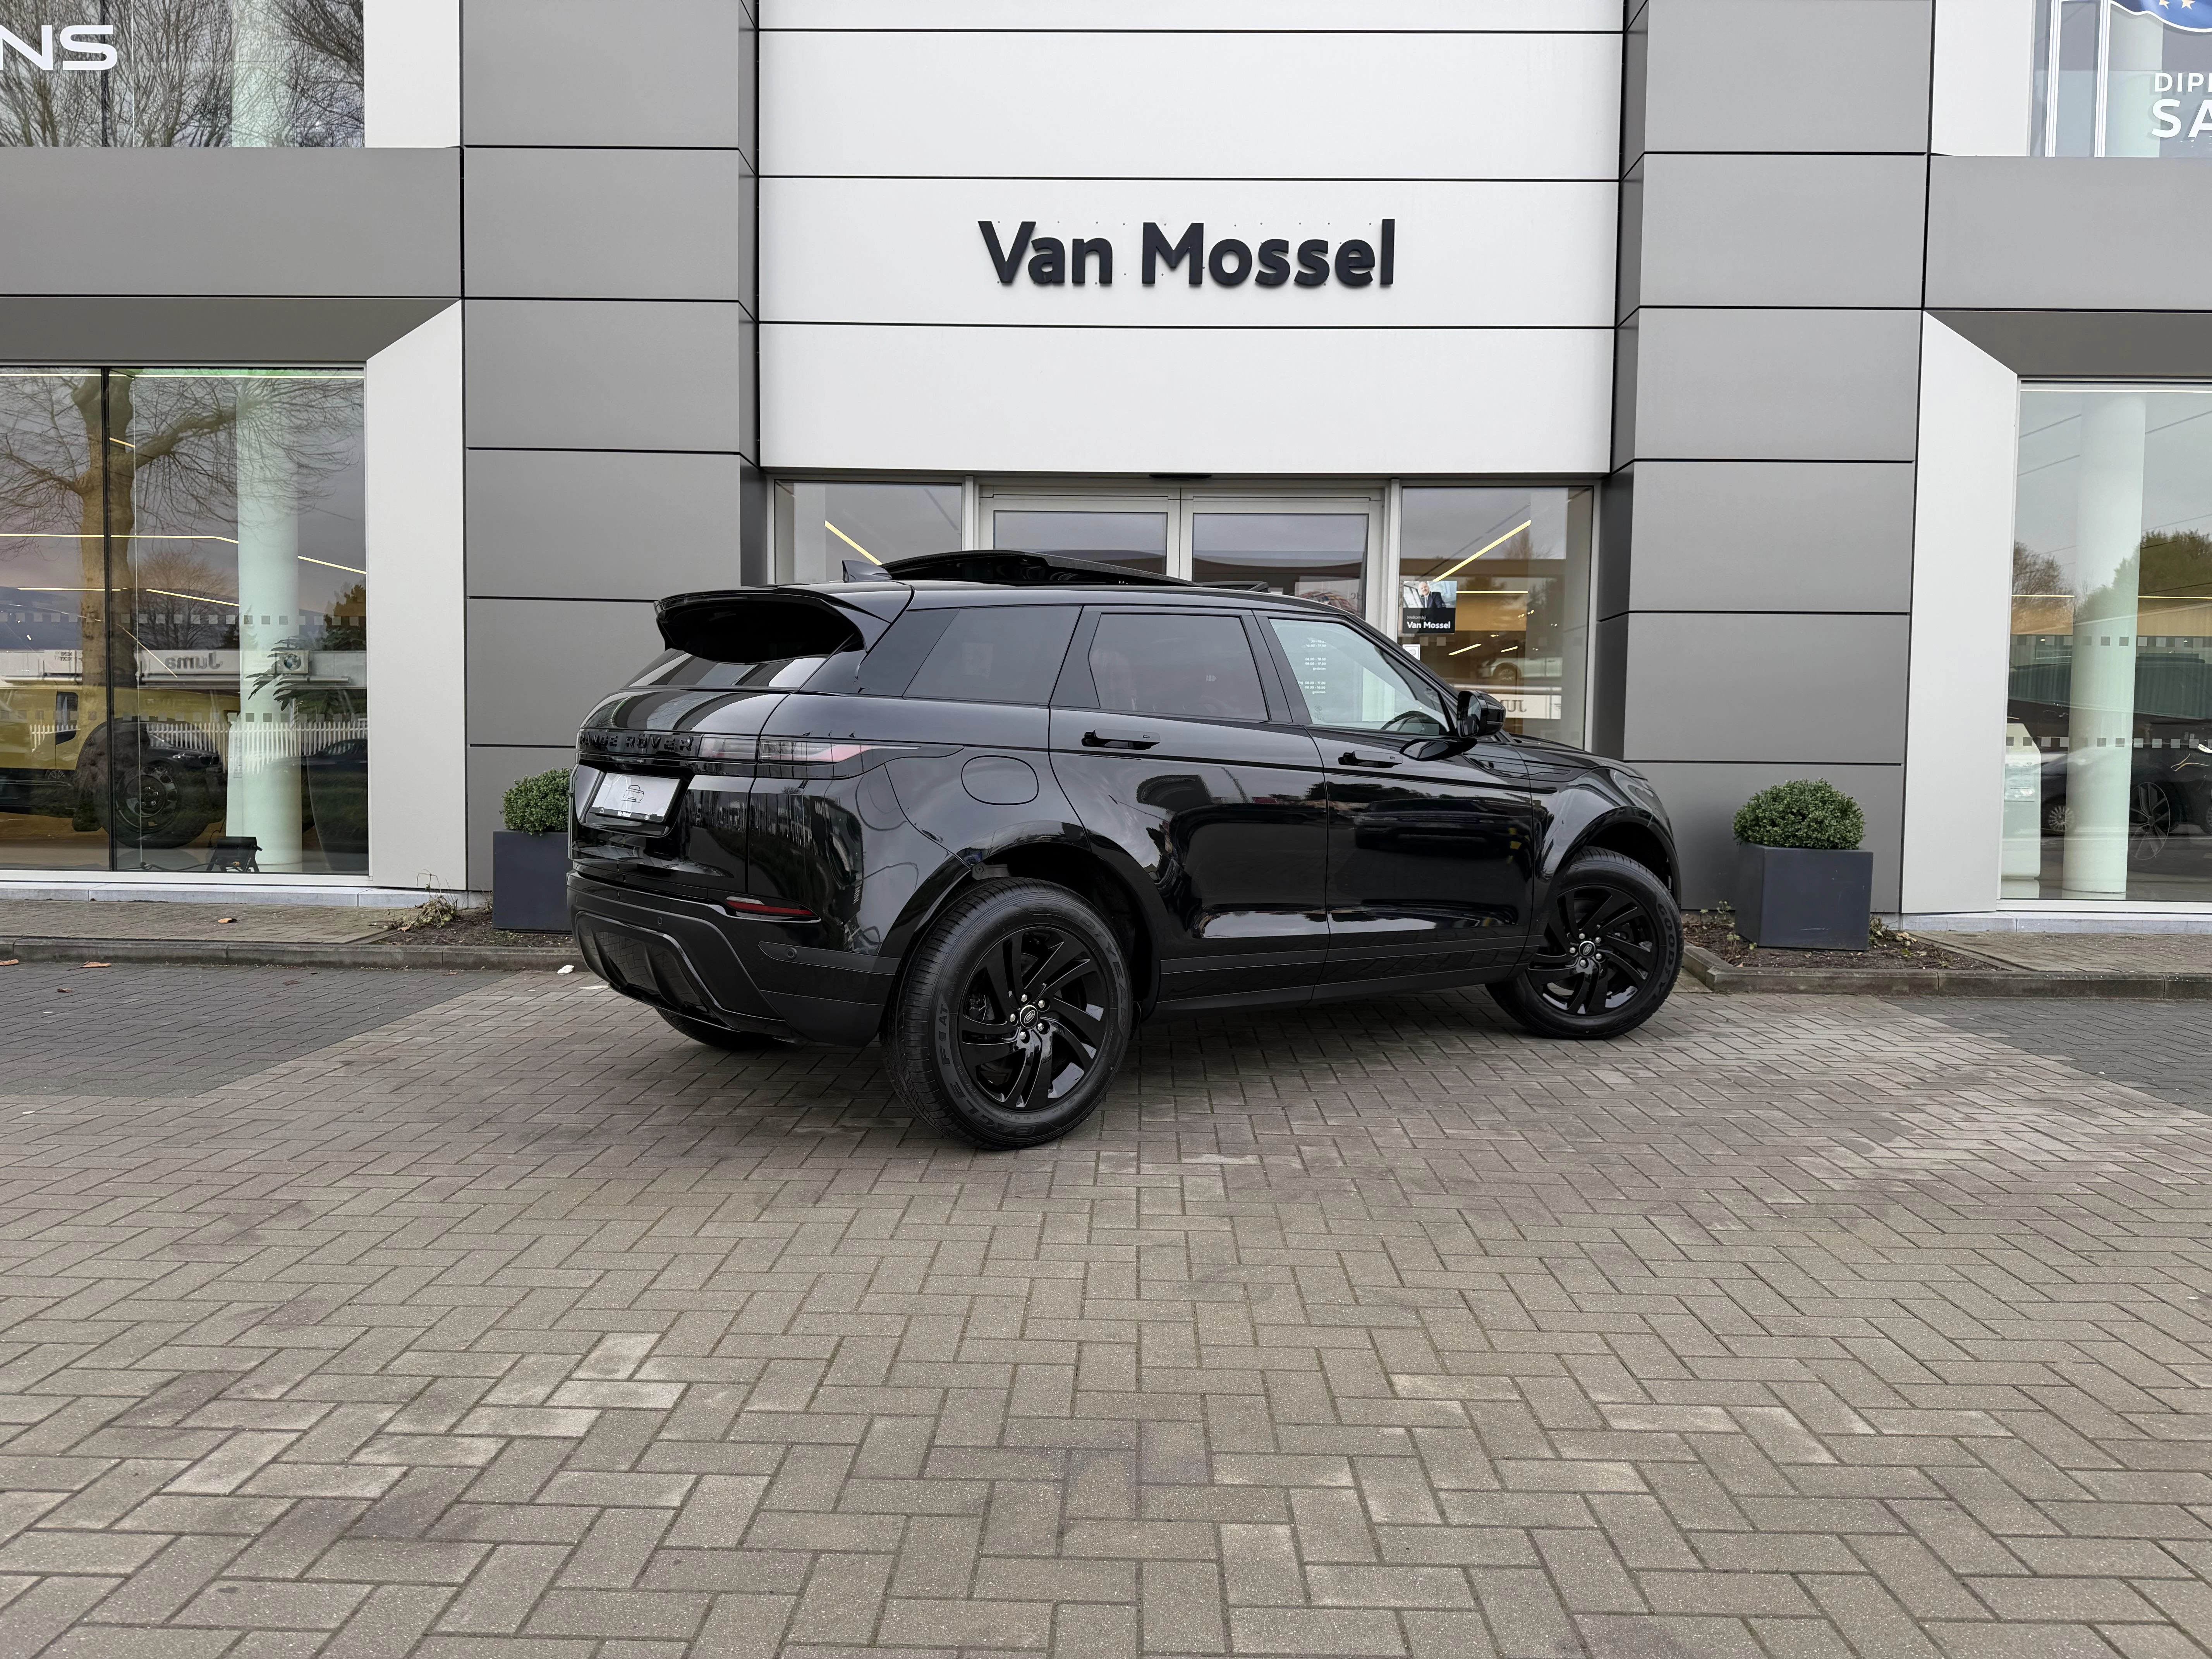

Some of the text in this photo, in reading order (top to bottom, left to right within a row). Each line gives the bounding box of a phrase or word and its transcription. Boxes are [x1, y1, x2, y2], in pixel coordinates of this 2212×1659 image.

[0, 24, 118, 71] NS
[978, 219, 1395, 286] Van Mossel
[1423, 621, 1451, 629] Mossel
[579, 734, 693, 751] RANGE ROVER
[1028, 903, 1128, 1029] GOODYEAR
[949, 1081, 1036, 1135] EAGLE
